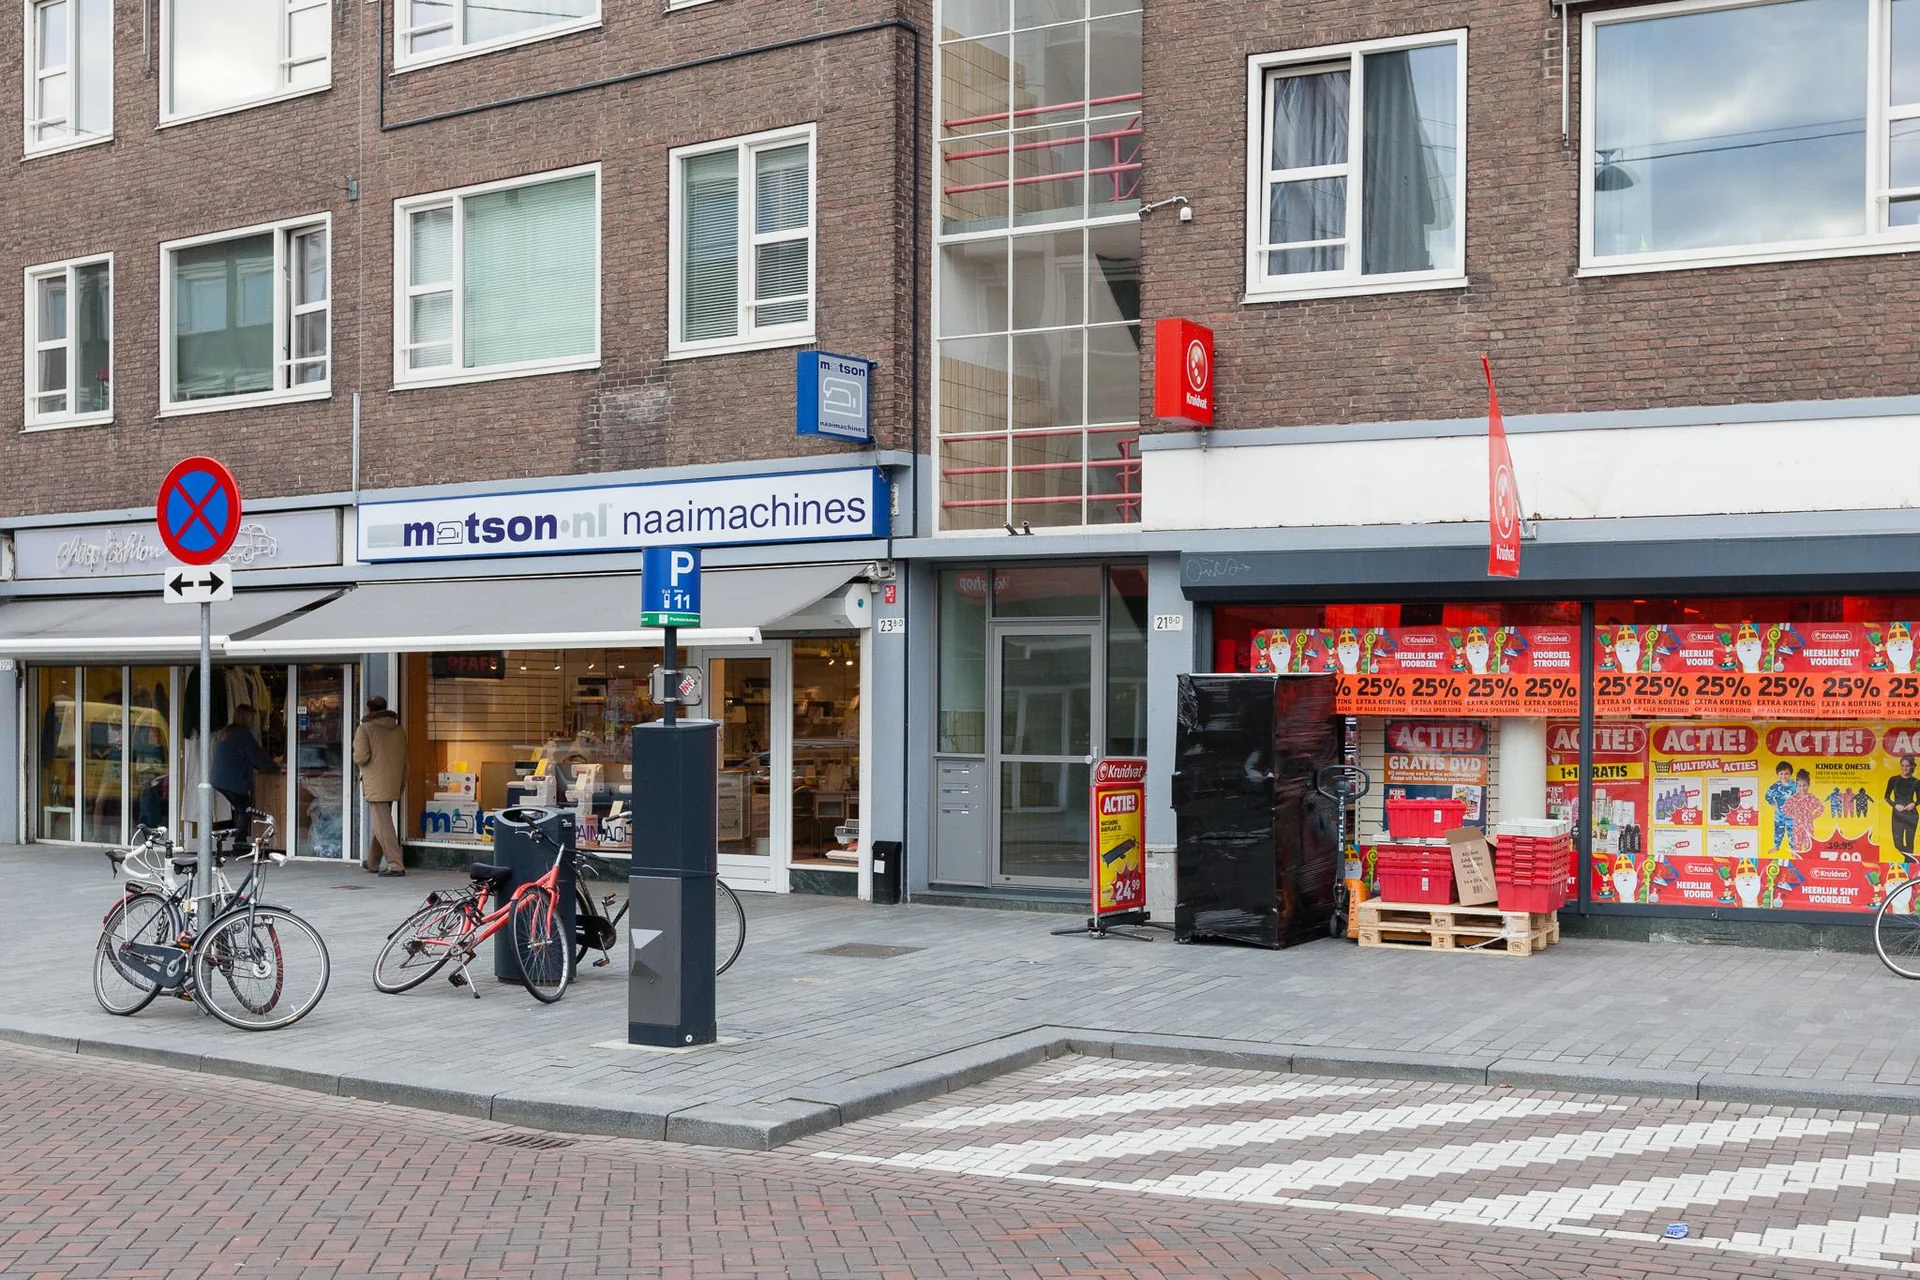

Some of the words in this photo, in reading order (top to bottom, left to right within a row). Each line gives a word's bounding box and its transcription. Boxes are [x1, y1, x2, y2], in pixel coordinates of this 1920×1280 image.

[623, 493, 866, 535] naaimachines
[671, 551, 694, 587] P
[674, 594, 690, 609] 11
[1533, 651, 1571, 659] VOORDEEL
[1686, 658, 1714, 666] VOORD
[1803, 649, 1839, 657] HEERLIJK
[1841, 649, 1860, 657] SINT
[1810, 658, 1852, 666] VOORDEEL
[1401, 660, 1437, 668] VOORDEEL
[1357, 678, 1406, 697] 25%
[1412, 678, 1461, 697] 25%
[1468, 678, 1518, 698] 25%
[1525, 678, 1577, 698] 25%
[1598, 676, 1632, 696] 25
[1635, 676, 1689, 696] 25%
[1696, 676, 1751, 697] 25%
[1758, 676, 1815, 698] 25%
[1823, 677, 1880, 698] 25%
[1888, 677, 1920, 698] 25
[1396, 727, 1474, 748] ACTIE!
[1662, 728, 1746, 752] ACTIE!
[1776, 730, 1863, 753] ACTIE!
[1108, 764, 1144, 778] Kruidvat
[1389, 756, 1444, 770] GRATIS
[1450, 758, 1481, 770] DVD
[1560, 768, 1578, 778] 1+1
[1592, 766, 1628, 778] RATIS
[1672, 760, 1720, 772] MULTIPAK
[1724, 761, 1757, 772] ACTIES
[1104, 795, 1135, 813] ACTIE!
[1821, 870, 1848, 878] Kruidvat
[1684, 890, 1713, 898] VOORD
[1802, 886, 1838, 894] HEERLIJK
[1840, 888, 1859, 896] SINT
[1809, 895, 1851, 904] VOORDEEL
